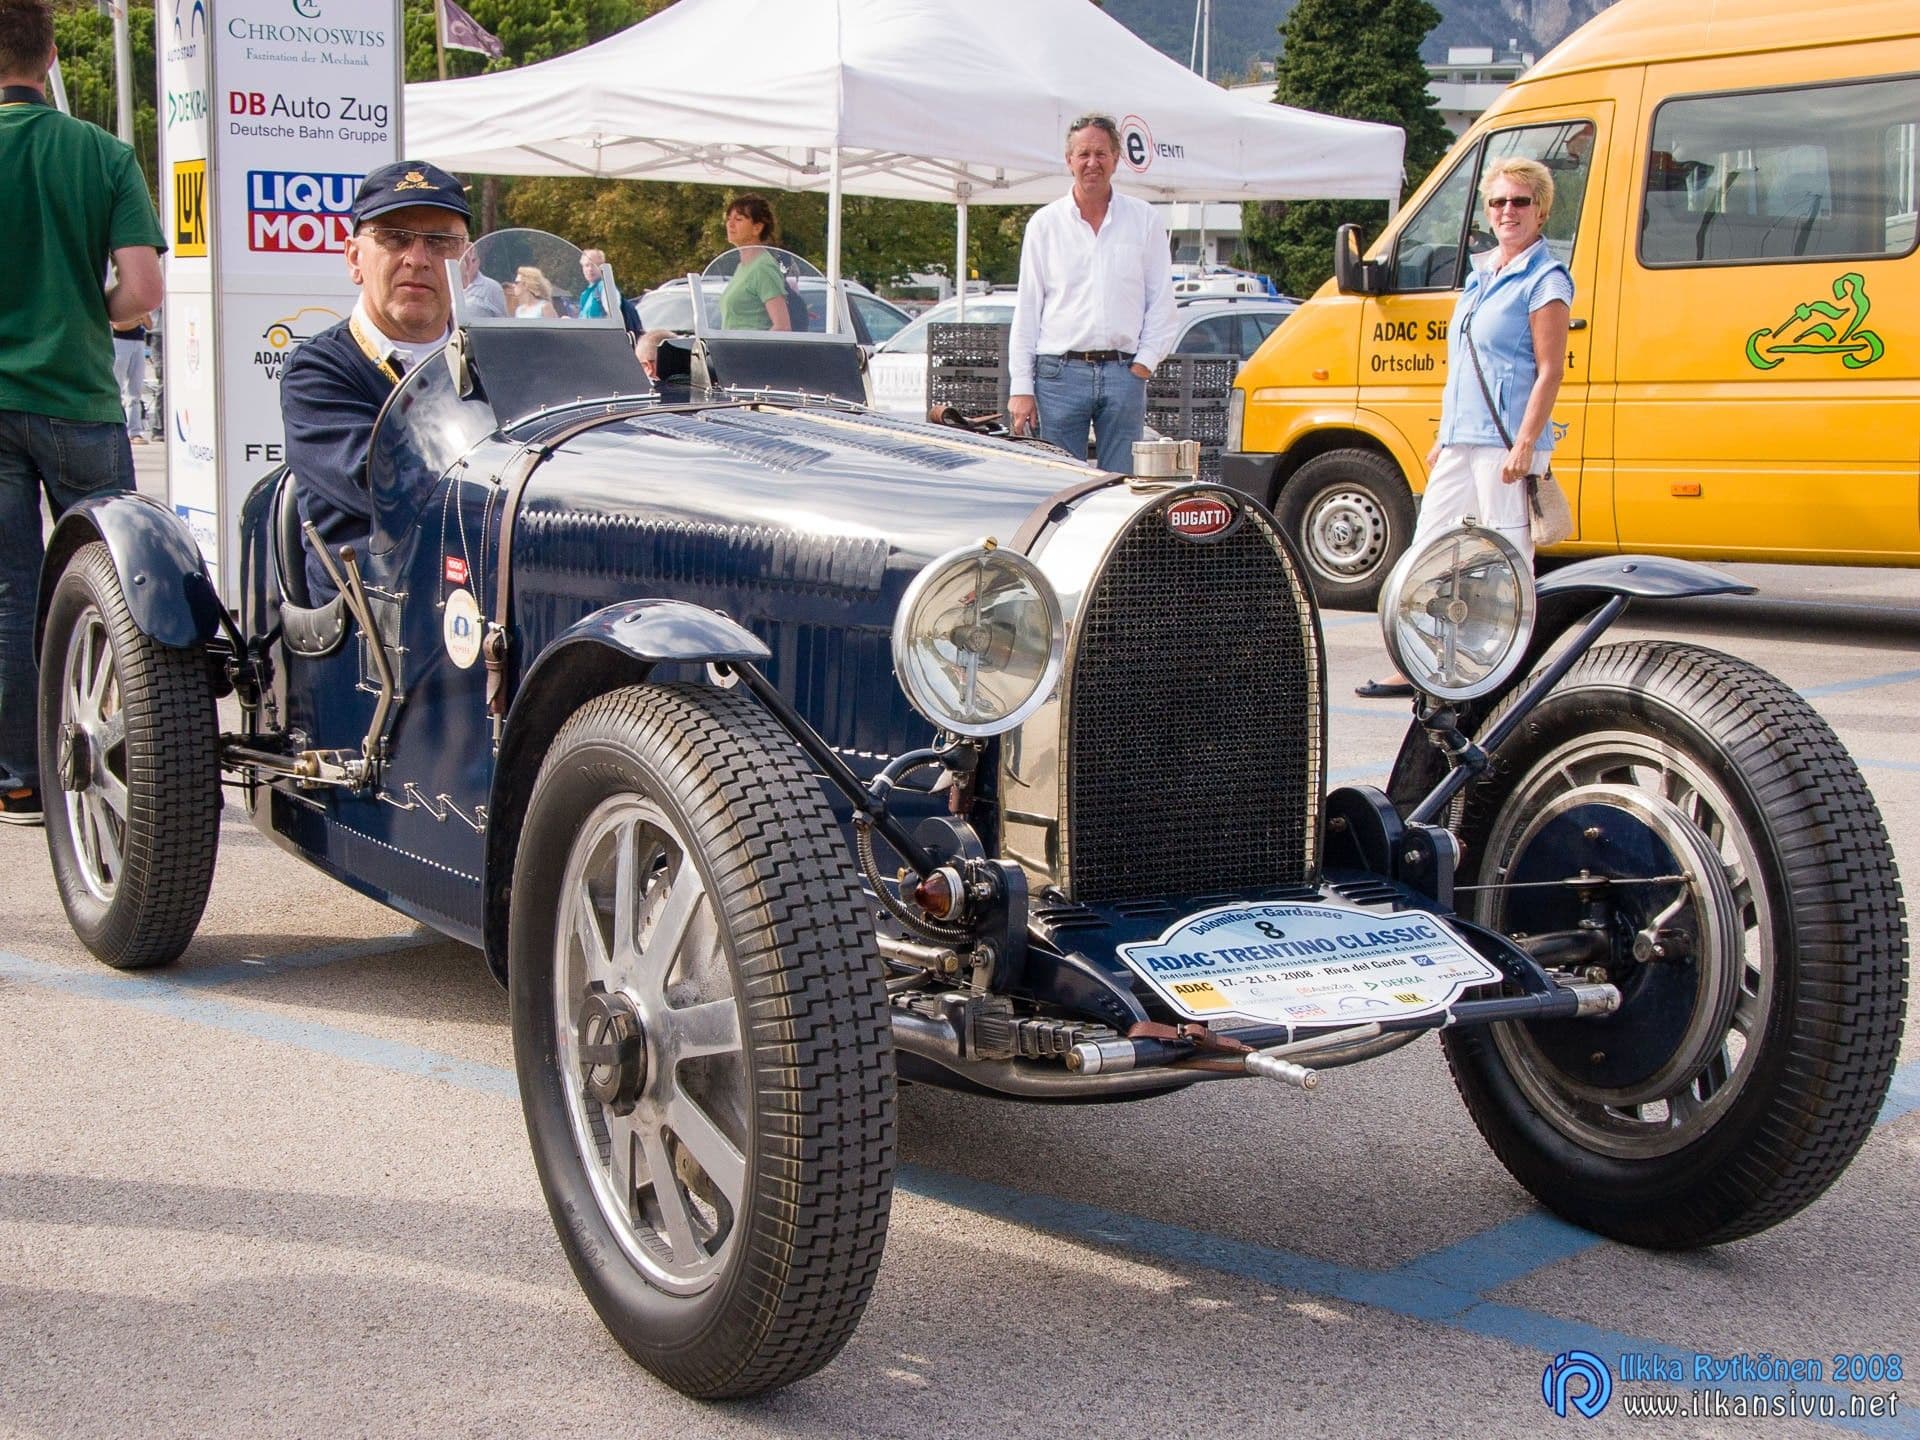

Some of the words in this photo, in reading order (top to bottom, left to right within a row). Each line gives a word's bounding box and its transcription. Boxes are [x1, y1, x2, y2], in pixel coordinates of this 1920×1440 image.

[228, 18, 385, 47] CHRONOSWISS
[246, 48, 298, 63] Faszination
[301, 52, 316, 64] der
[320, 53, 369, 67] Mechanik
[179, 90, 207, 122] DEKRA
[229, 91, 266, 116] DB
[271, 94, 330, 119] Auto
[340, 97, 388, 128] Zug
[230, 122, 294, 138] Deutsche
[299, 126, 334, 140] Bahn
[338, 128, 388, 144] Gruppe
[1373, 321, 1418, 341] ADAC
[1371, 353, 1434, 372] Ortsclub
[1171, 510, 1226, 526] BUGATTI
[1189, 907, 1343, 935] Dolomiten-Gardasee
[1254, 920, 1285, 939] 8
[1146, 952, 1215, 972] ADAC
[1213, 937, 1337, 964] TRENTINO
[1336, 925, 1437, 949] CLASSIC
[1324, 963, 1350, 976] Riva
[1353, 960, 1369, 972] del
[1370, 956, 1407, 969] Garda
[1174, 982, 1214, 995] ADAC
[1380, 975, 1426, 988] DEKRA
